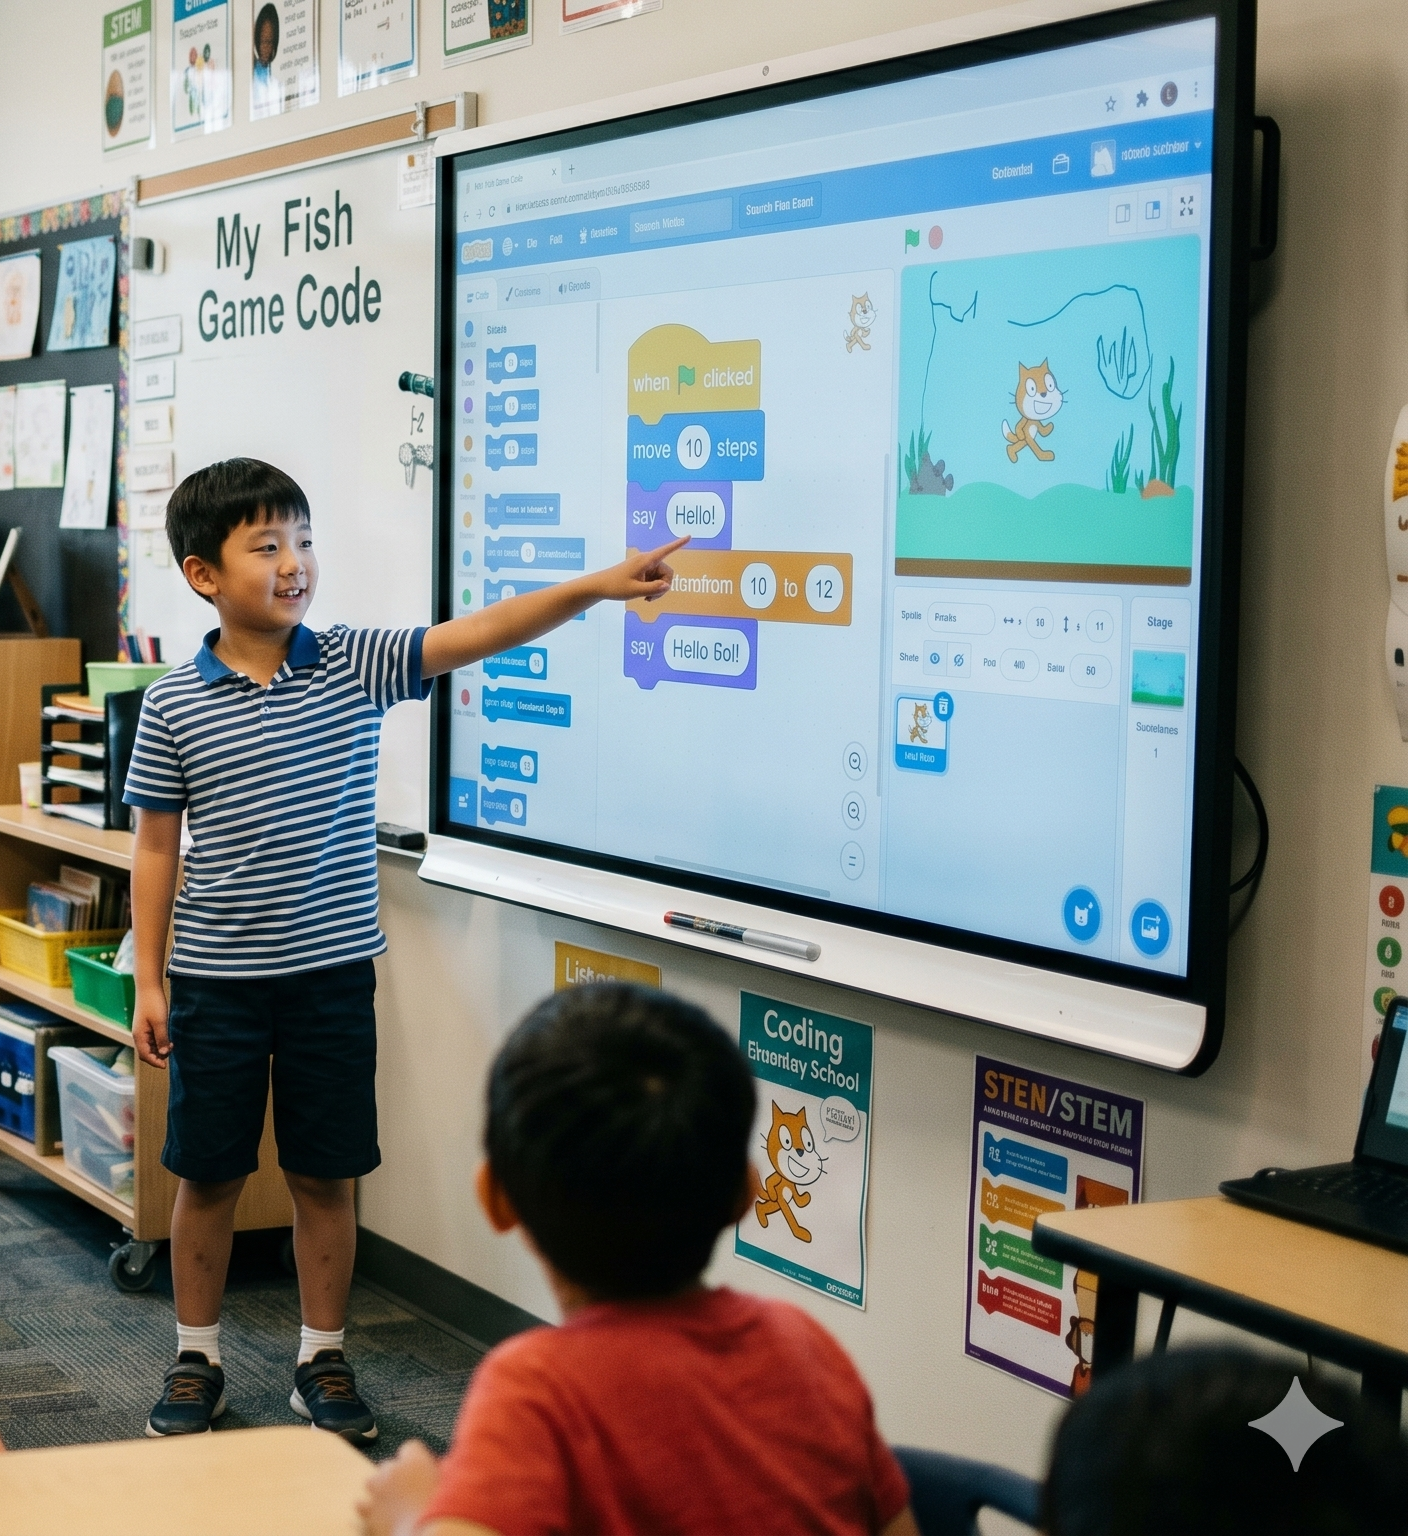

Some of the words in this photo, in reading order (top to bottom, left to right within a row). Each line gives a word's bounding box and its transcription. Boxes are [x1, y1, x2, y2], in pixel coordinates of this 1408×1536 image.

[110, 6, 142, 40] STEM
[216, 212, 261, 281] My
[284, 189, 353, 258] Fish
[198, 289, 285, 343] Game
[296, 265, 382, 331] Code
[633, 374, 670, 393] when
[703, 365, 754, 389] clicked
[633, 442, 671, 459] move
[686, 438, 703, 458] 10
[717, 439, 757, 462] steps
[632, 509, 657, 528] say
[674, 505, 716, 525] Hello!
[750, 577, 767, 596] 10
[783, 578, 798, 597] to
[816, 579, 833, 599] 12
[1147, 616, 1173, 630] Stage
[630, 640, 655, 661] say
[673, 638, 709, 660] Hello
[763, 1009, 843, 1066] Coding
[810, 1060, 859, 1092] School
